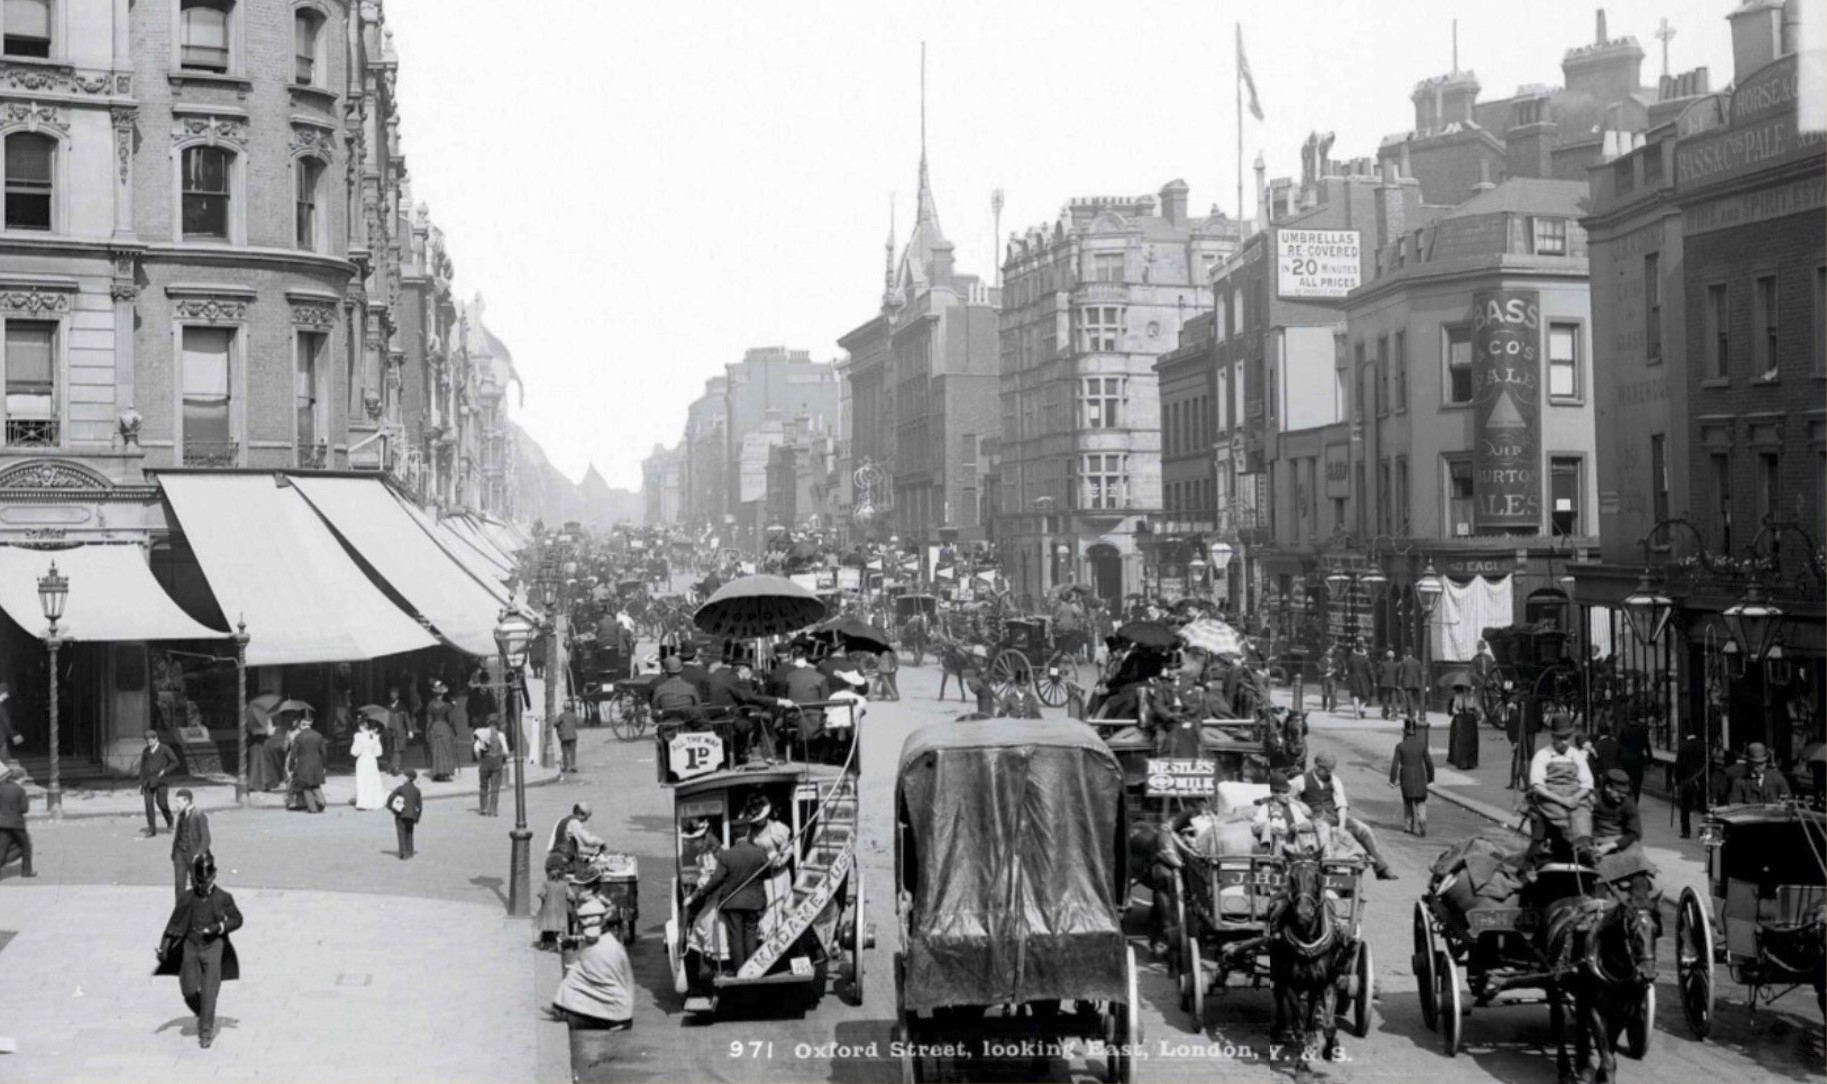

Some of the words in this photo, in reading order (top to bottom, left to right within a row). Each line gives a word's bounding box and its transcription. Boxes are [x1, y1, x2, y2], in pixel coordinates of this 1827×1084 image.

[1745, 123, 1786, 164] PALE
[1281, 232, 1355, 244] UMBRELLAS
[1288, 245, 1358, 257] RE-COVERED
[1292, 258, 1318, 275] 20
[1299, 277, 1317, 287] ALL
[1321, 277, 1356, 288] PRICES
[1475, 299, 1537, 330] BASS
